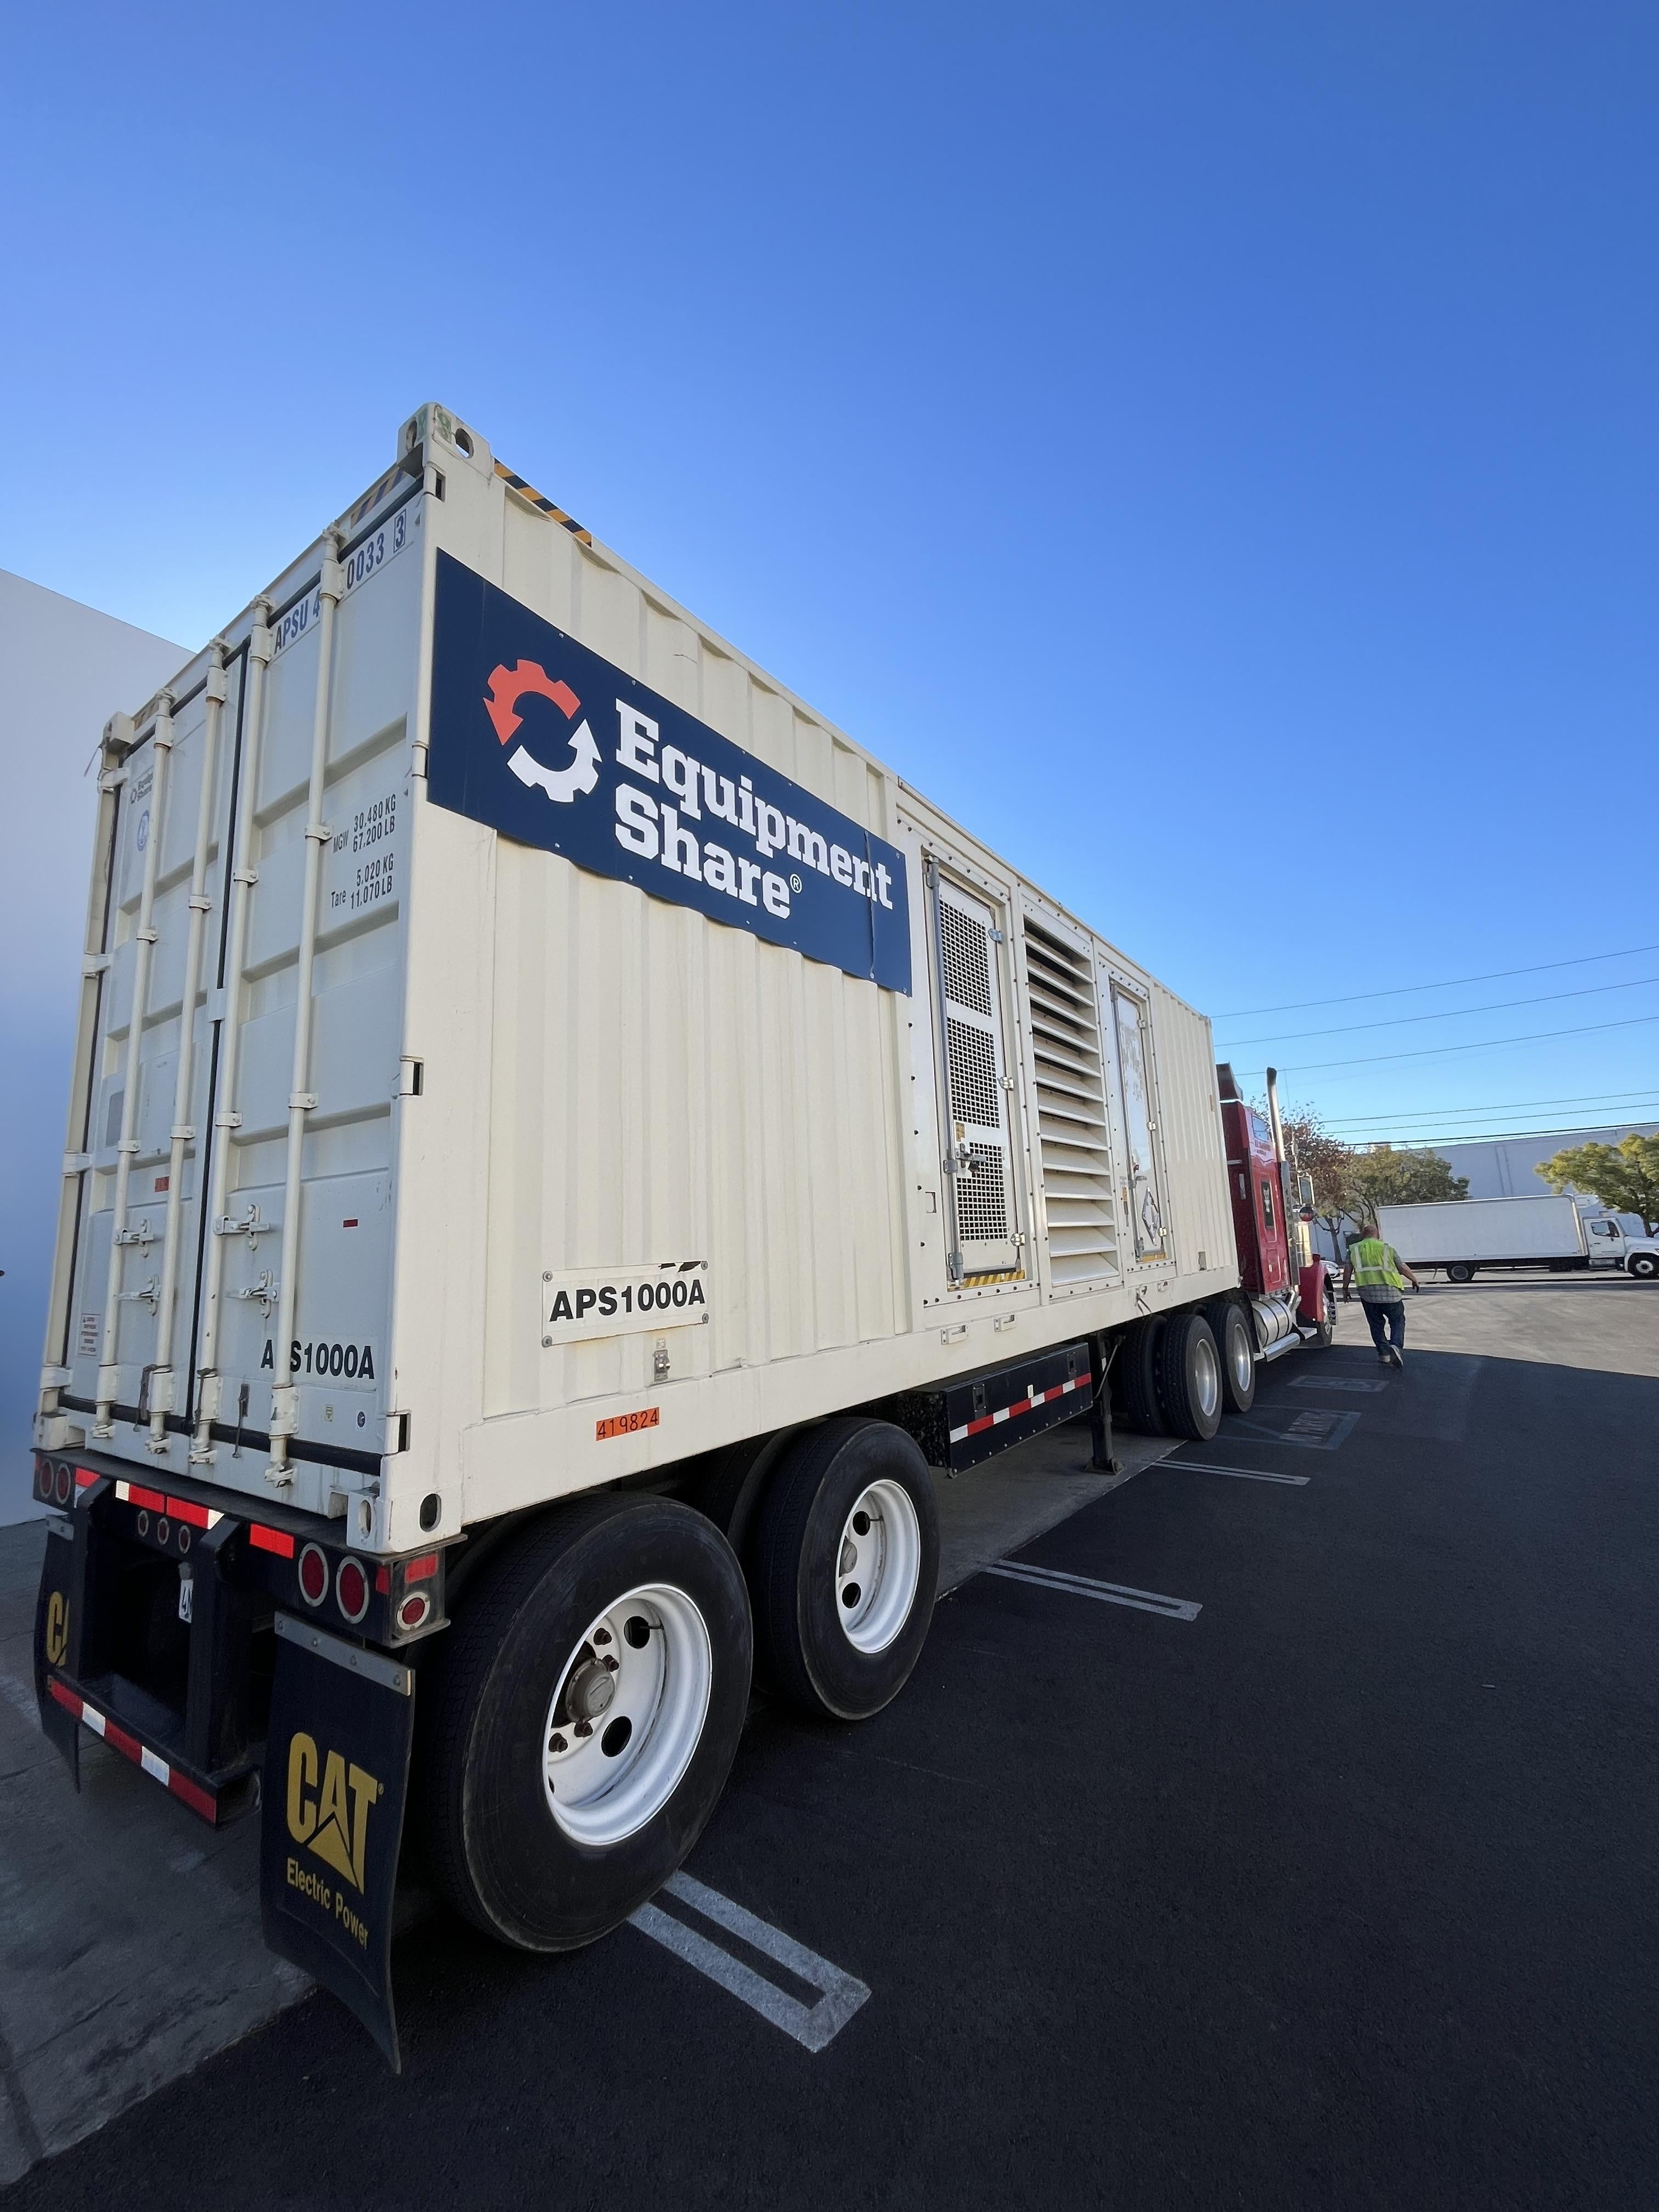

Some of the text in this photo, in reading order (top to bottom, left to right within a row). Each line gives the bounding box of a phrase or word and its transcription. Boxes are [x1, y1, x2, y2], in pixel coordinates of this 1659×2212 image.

[274, 599, 308, 654] APSU
[395, 515, 404, 548] 3
[385, 794, 396, 815] KG
[616, 698, 893, 910] Equipment
[385, 815, 395, 836] LB
[333, 830, 349, 853] MGW
[383, 853, 393, 874] KG
[382, 875, 392, 895] LB
[331, 890, 346, 908] Tare
[549, 1279, 706, 1322] APS1000A
[261, 1339, 375, 1380] AS1000A
[597, 1409, 658, 1438] 419824
[287, 1857, 369, 1950] Electric Power
